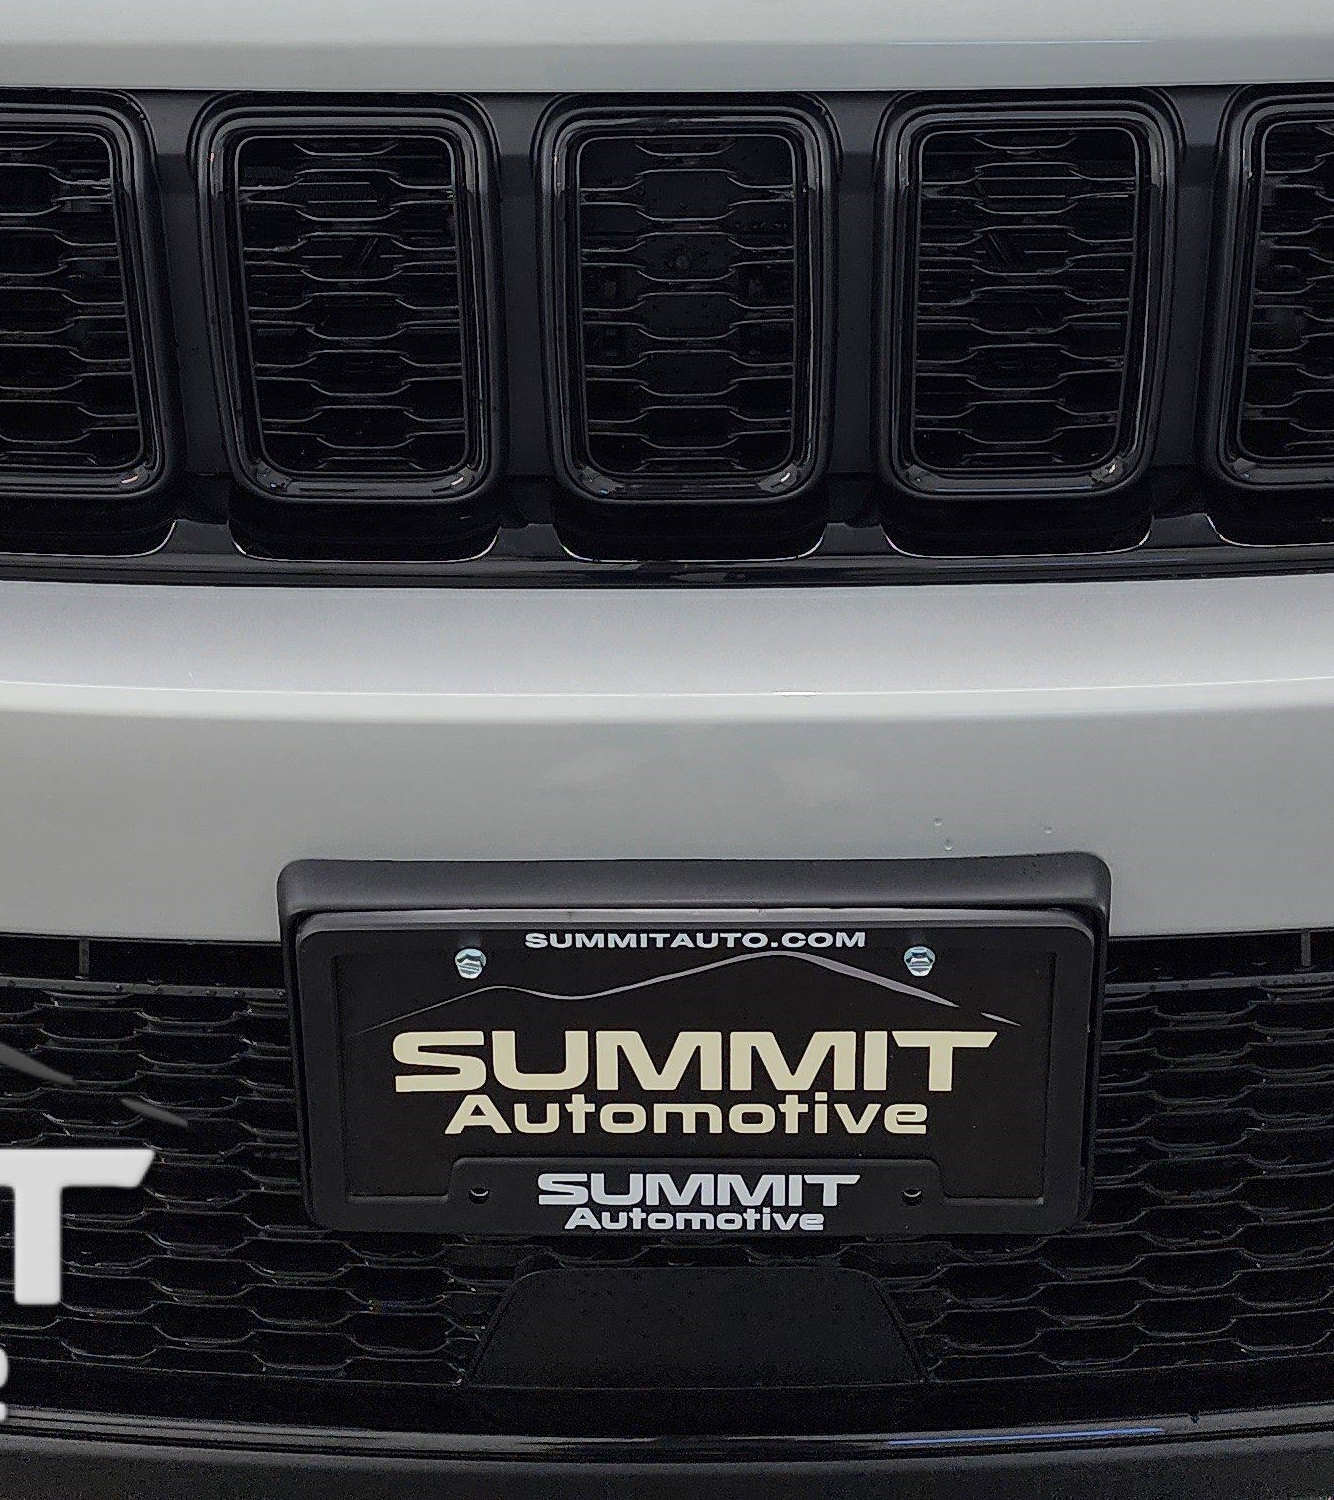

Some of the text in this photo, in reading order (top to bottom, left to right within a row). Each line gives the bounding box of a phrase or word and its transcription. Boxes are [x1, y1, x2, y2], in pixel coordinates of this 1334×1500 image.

[524, 931, 867, 950] SUMMITAUTO.COM
[392, 1030, 998, 1095] SUMMIT
[444, 1091, 929, 1135] Automotive
[537, 1172, 861, 1207] SUMMIT
[563, 1205, 825, 1232] Automotive
